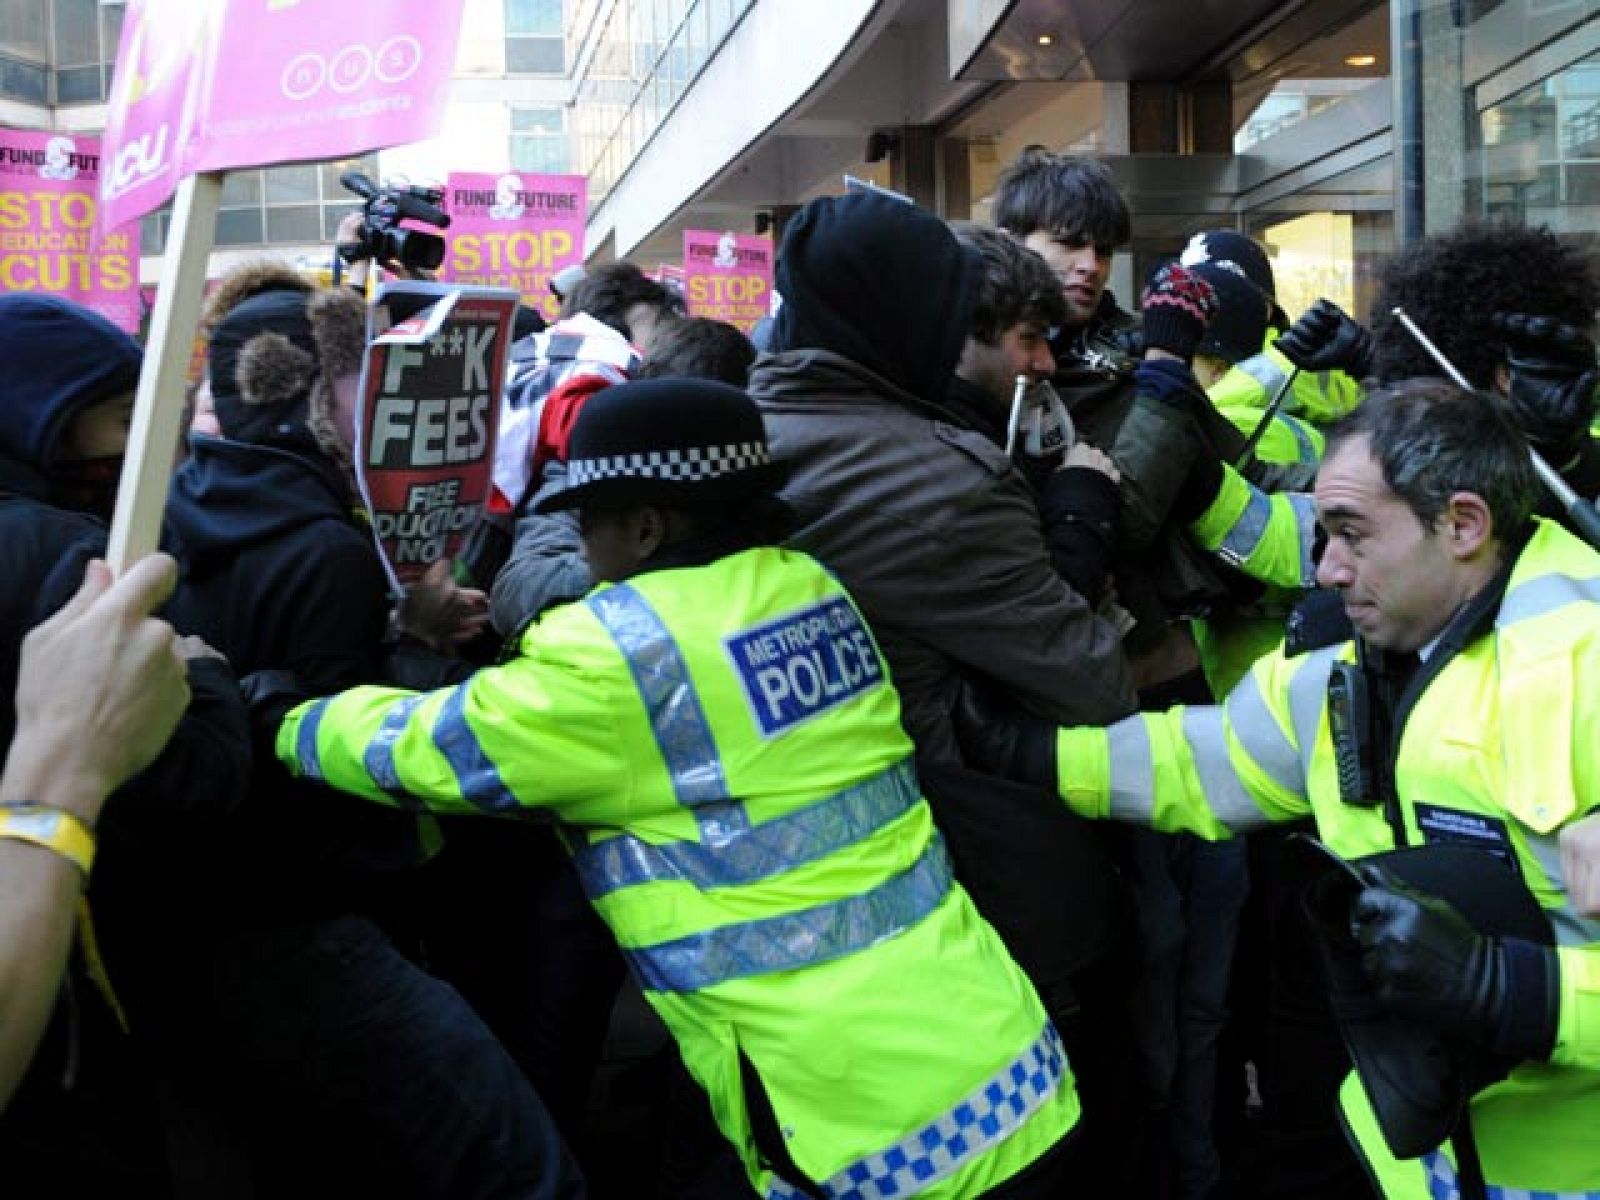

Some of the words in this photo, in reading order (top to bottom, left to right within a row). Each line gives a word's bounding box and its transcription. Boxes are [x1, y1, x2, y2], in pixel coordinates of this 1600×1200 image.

[69, 154, 99, 171] FUT
[0, 192, 97, 229] STO
[454, 190, 496, 205] FUND
[514, 191, 577, 210] FUTURE
[2, 233, 128, 250] EDUCATON
[453, 230, 572, 270] STOP
[0, 254, 131, 291] CUTS
[688, 275, 766, 303] STOP
[371, 395, 490, 466] FEES
[757, 631, 879, 721] POLICE
